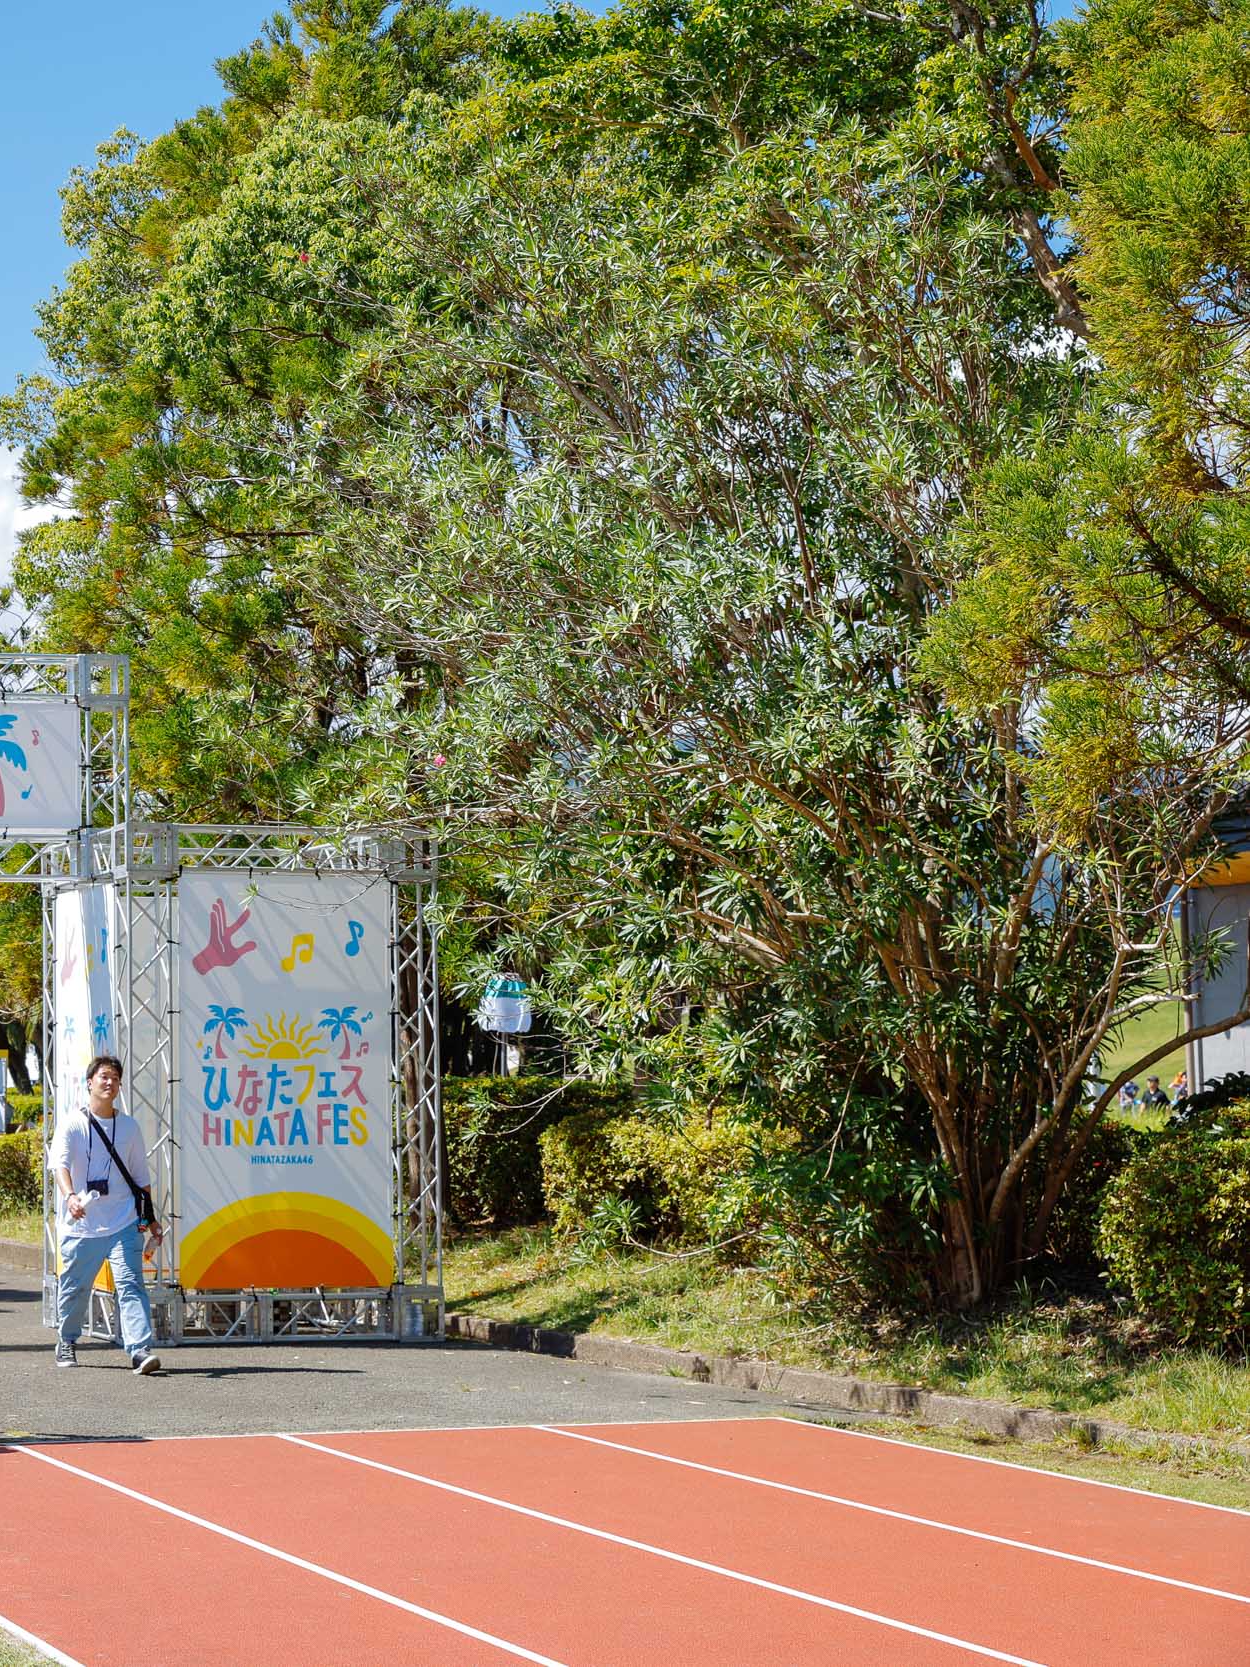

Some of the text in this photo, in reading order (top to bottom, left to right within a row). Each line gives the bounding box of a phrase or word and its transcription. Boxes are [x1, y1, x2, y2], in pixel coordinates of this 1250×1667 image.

[202, 1063, 367, 1116] ひなたフェス
[203, 1104, 368, 1146] HINATA FES
[251, 1154, 314, 1165] HINATAZAKA46
